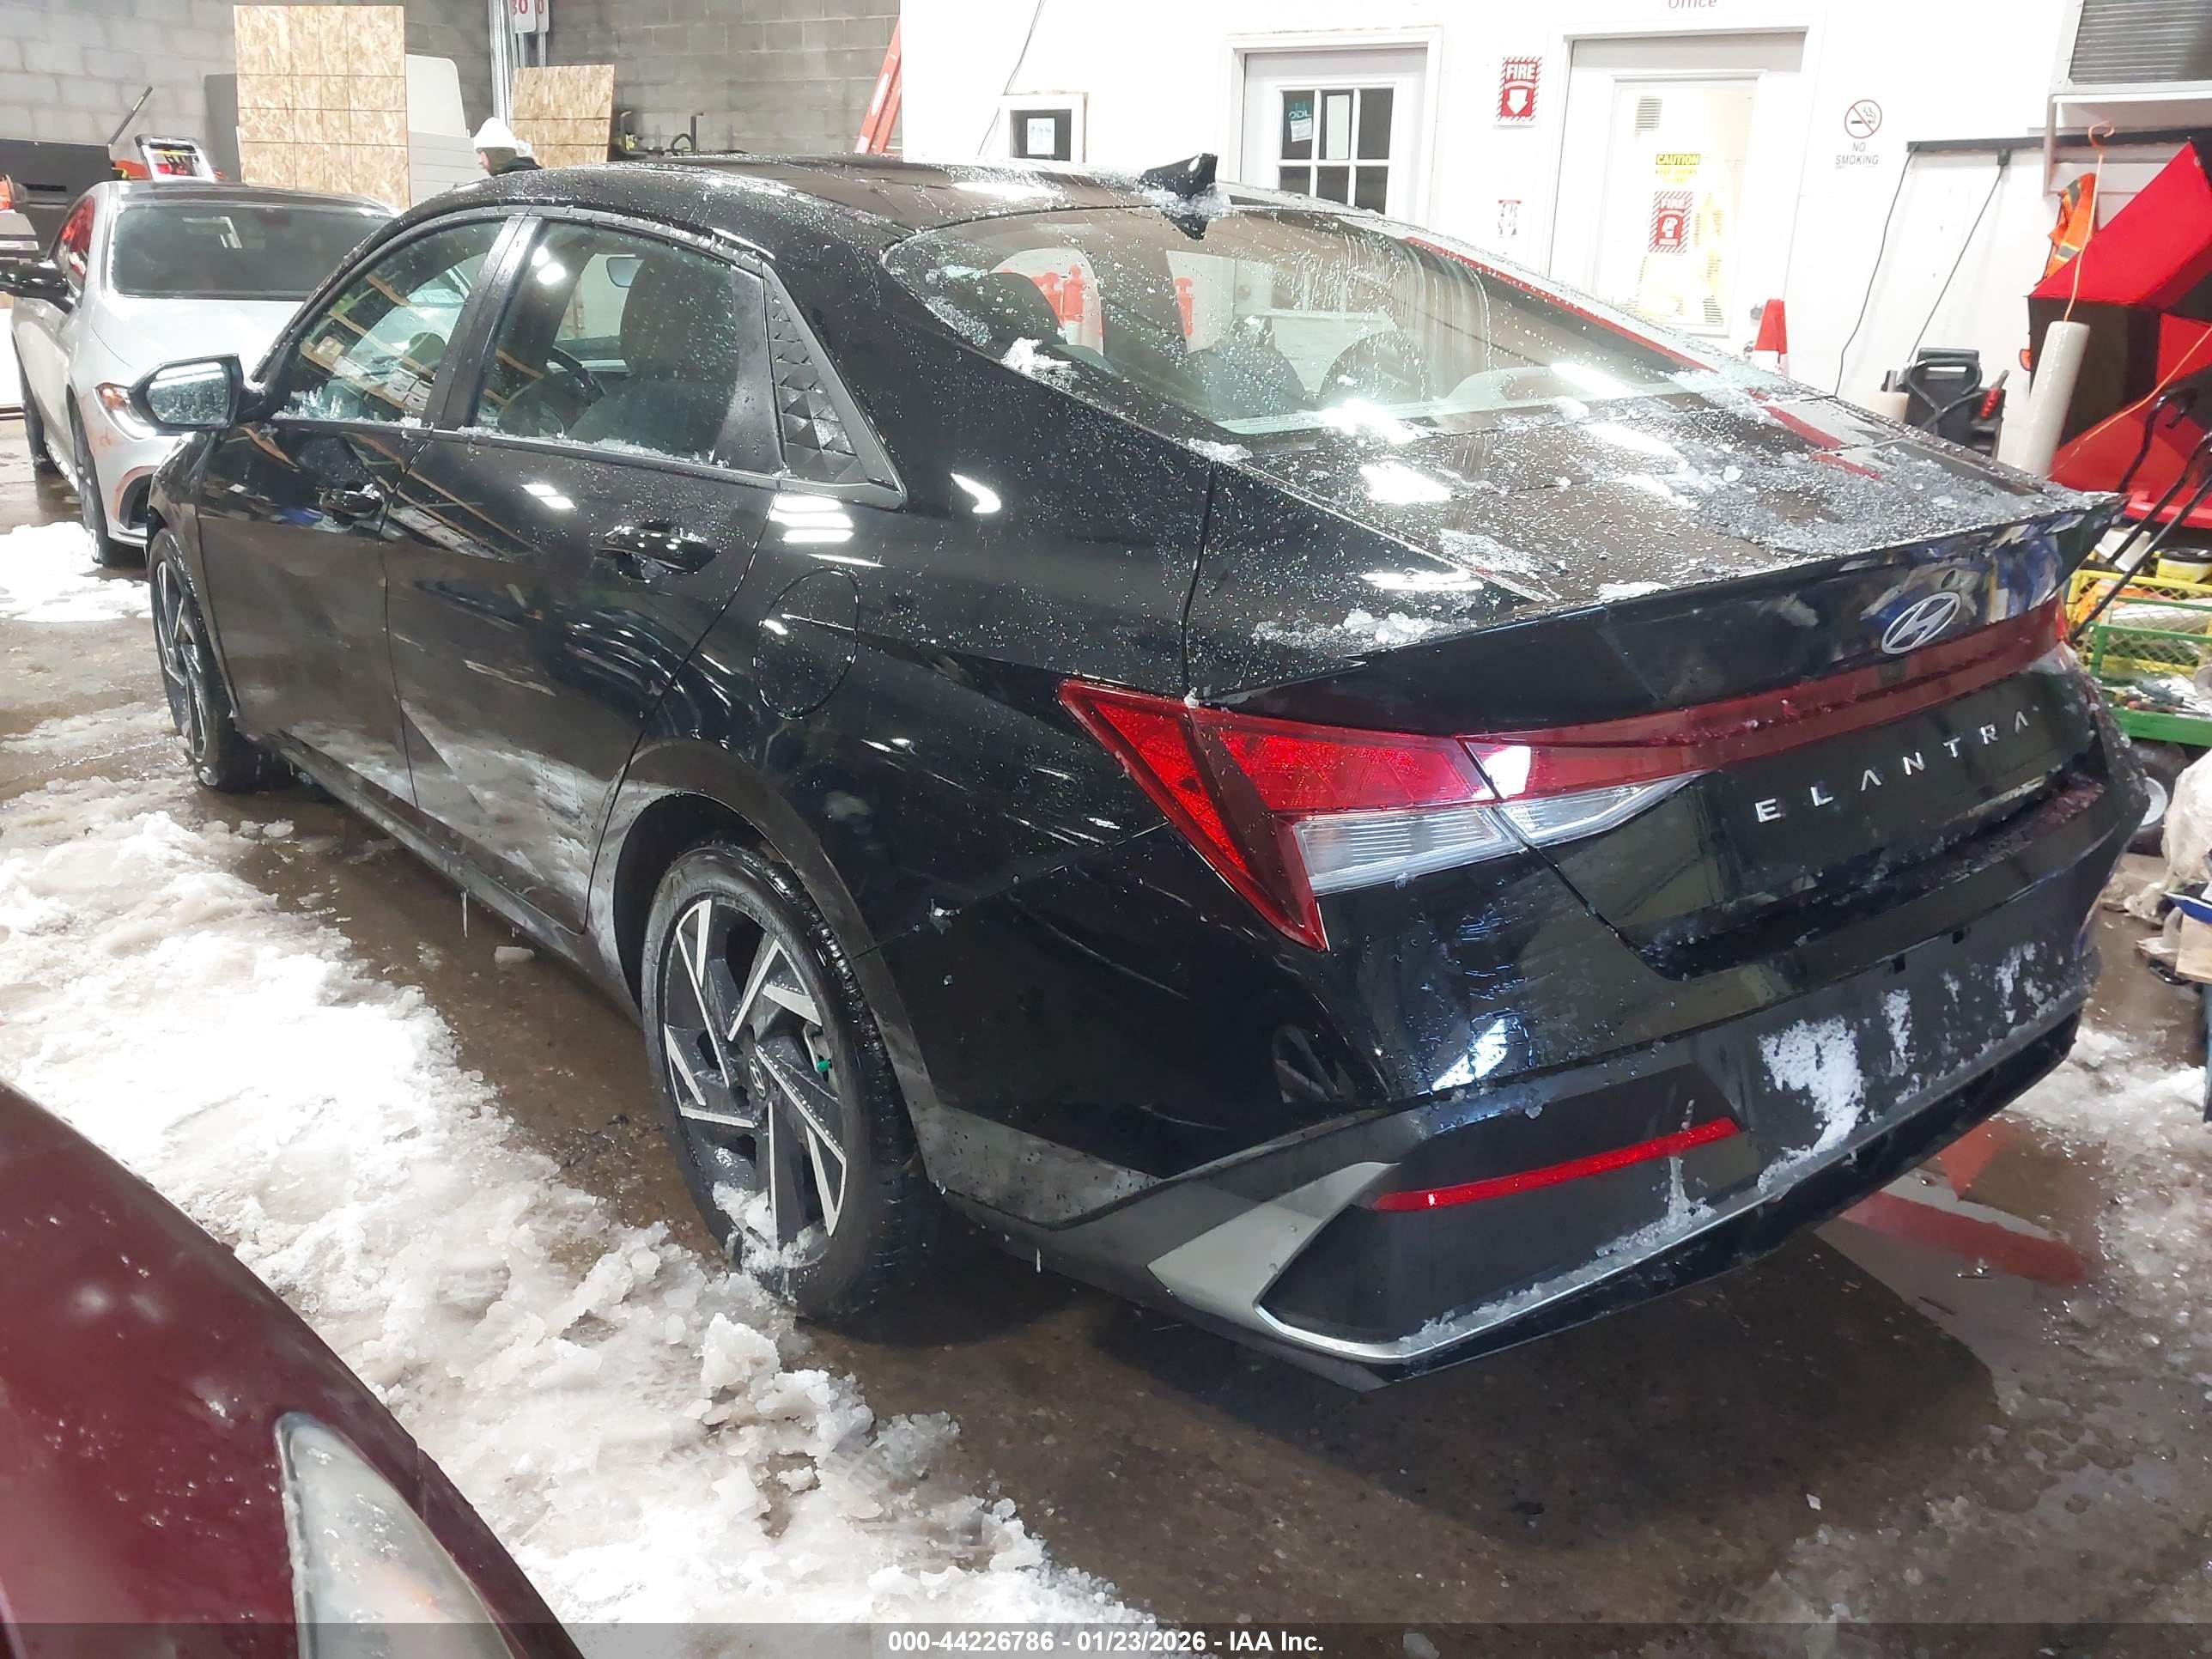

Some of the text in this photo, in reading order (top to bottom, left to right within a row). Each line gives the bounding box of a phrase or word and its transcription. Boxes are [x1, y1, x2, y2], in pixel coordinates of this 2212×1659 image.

[1506, 64, 1536, 80] FIRE
[1852, 142, 1866, 152] NO
[1657, 155, 1700, 165] CAUTION
[1835, 155, 1879, 165] SMOKING
[1660, 198, 1686, 209] FIRE
[1755, 712, 2029, 822] ELANTRA
